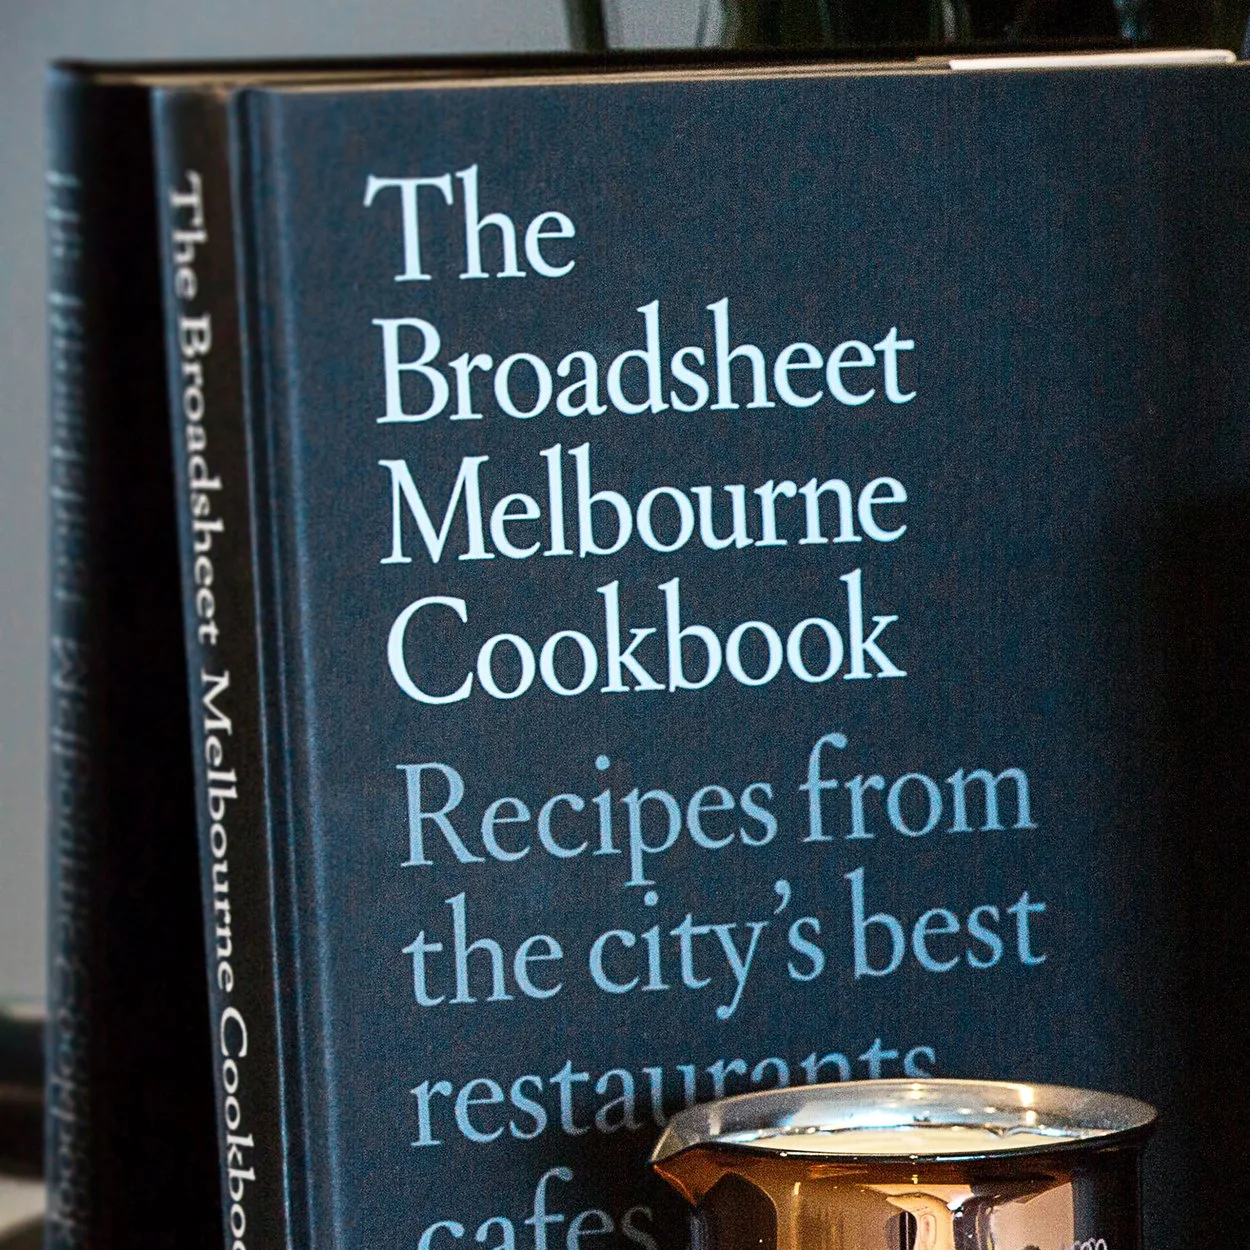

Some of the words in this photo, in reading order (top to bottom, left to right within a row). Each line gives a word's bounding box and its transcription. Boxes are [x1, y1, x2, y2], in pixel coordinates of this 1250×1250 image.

[168, 170, 209, 298] The
[364, 163, 577, 282] The
[371, 297, 917, 424] Broadsheet
[178, 315, 225, 646] Broadsheet
[378, 442, 908, 564] Melbourne
[387, 568, 908, 705] Cookbook
[200, 670, 239, 993] Melbourne
[395, 754, 779, 887] Recipes
[799, 732, 1037, 843] from
[401, 891, 564, 1008] the
[845, 866, 1047, 979] best
